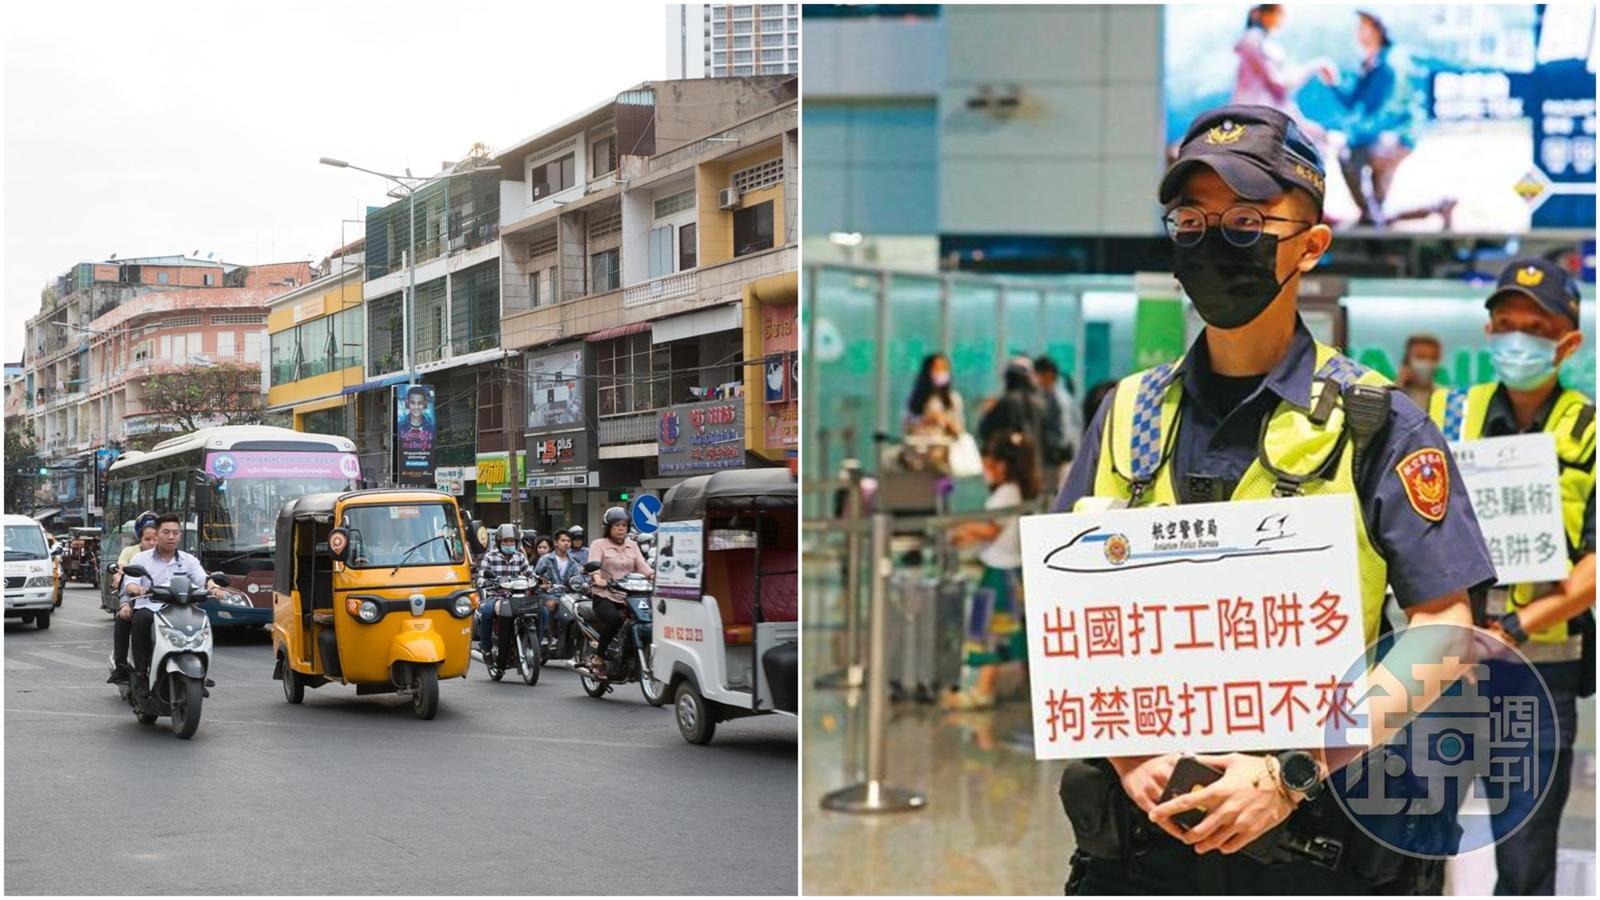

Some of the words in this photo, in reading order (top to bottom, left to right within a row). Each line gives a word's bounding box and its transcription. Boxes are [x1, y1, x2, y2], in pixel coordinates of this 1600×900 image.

[1152, 518, 1217, 540] 航空警察局
[1042, 590, 1350, 660] 出國打工陷阱多
[1046, 675, 1358, 744] 拘禁毆打回不來
